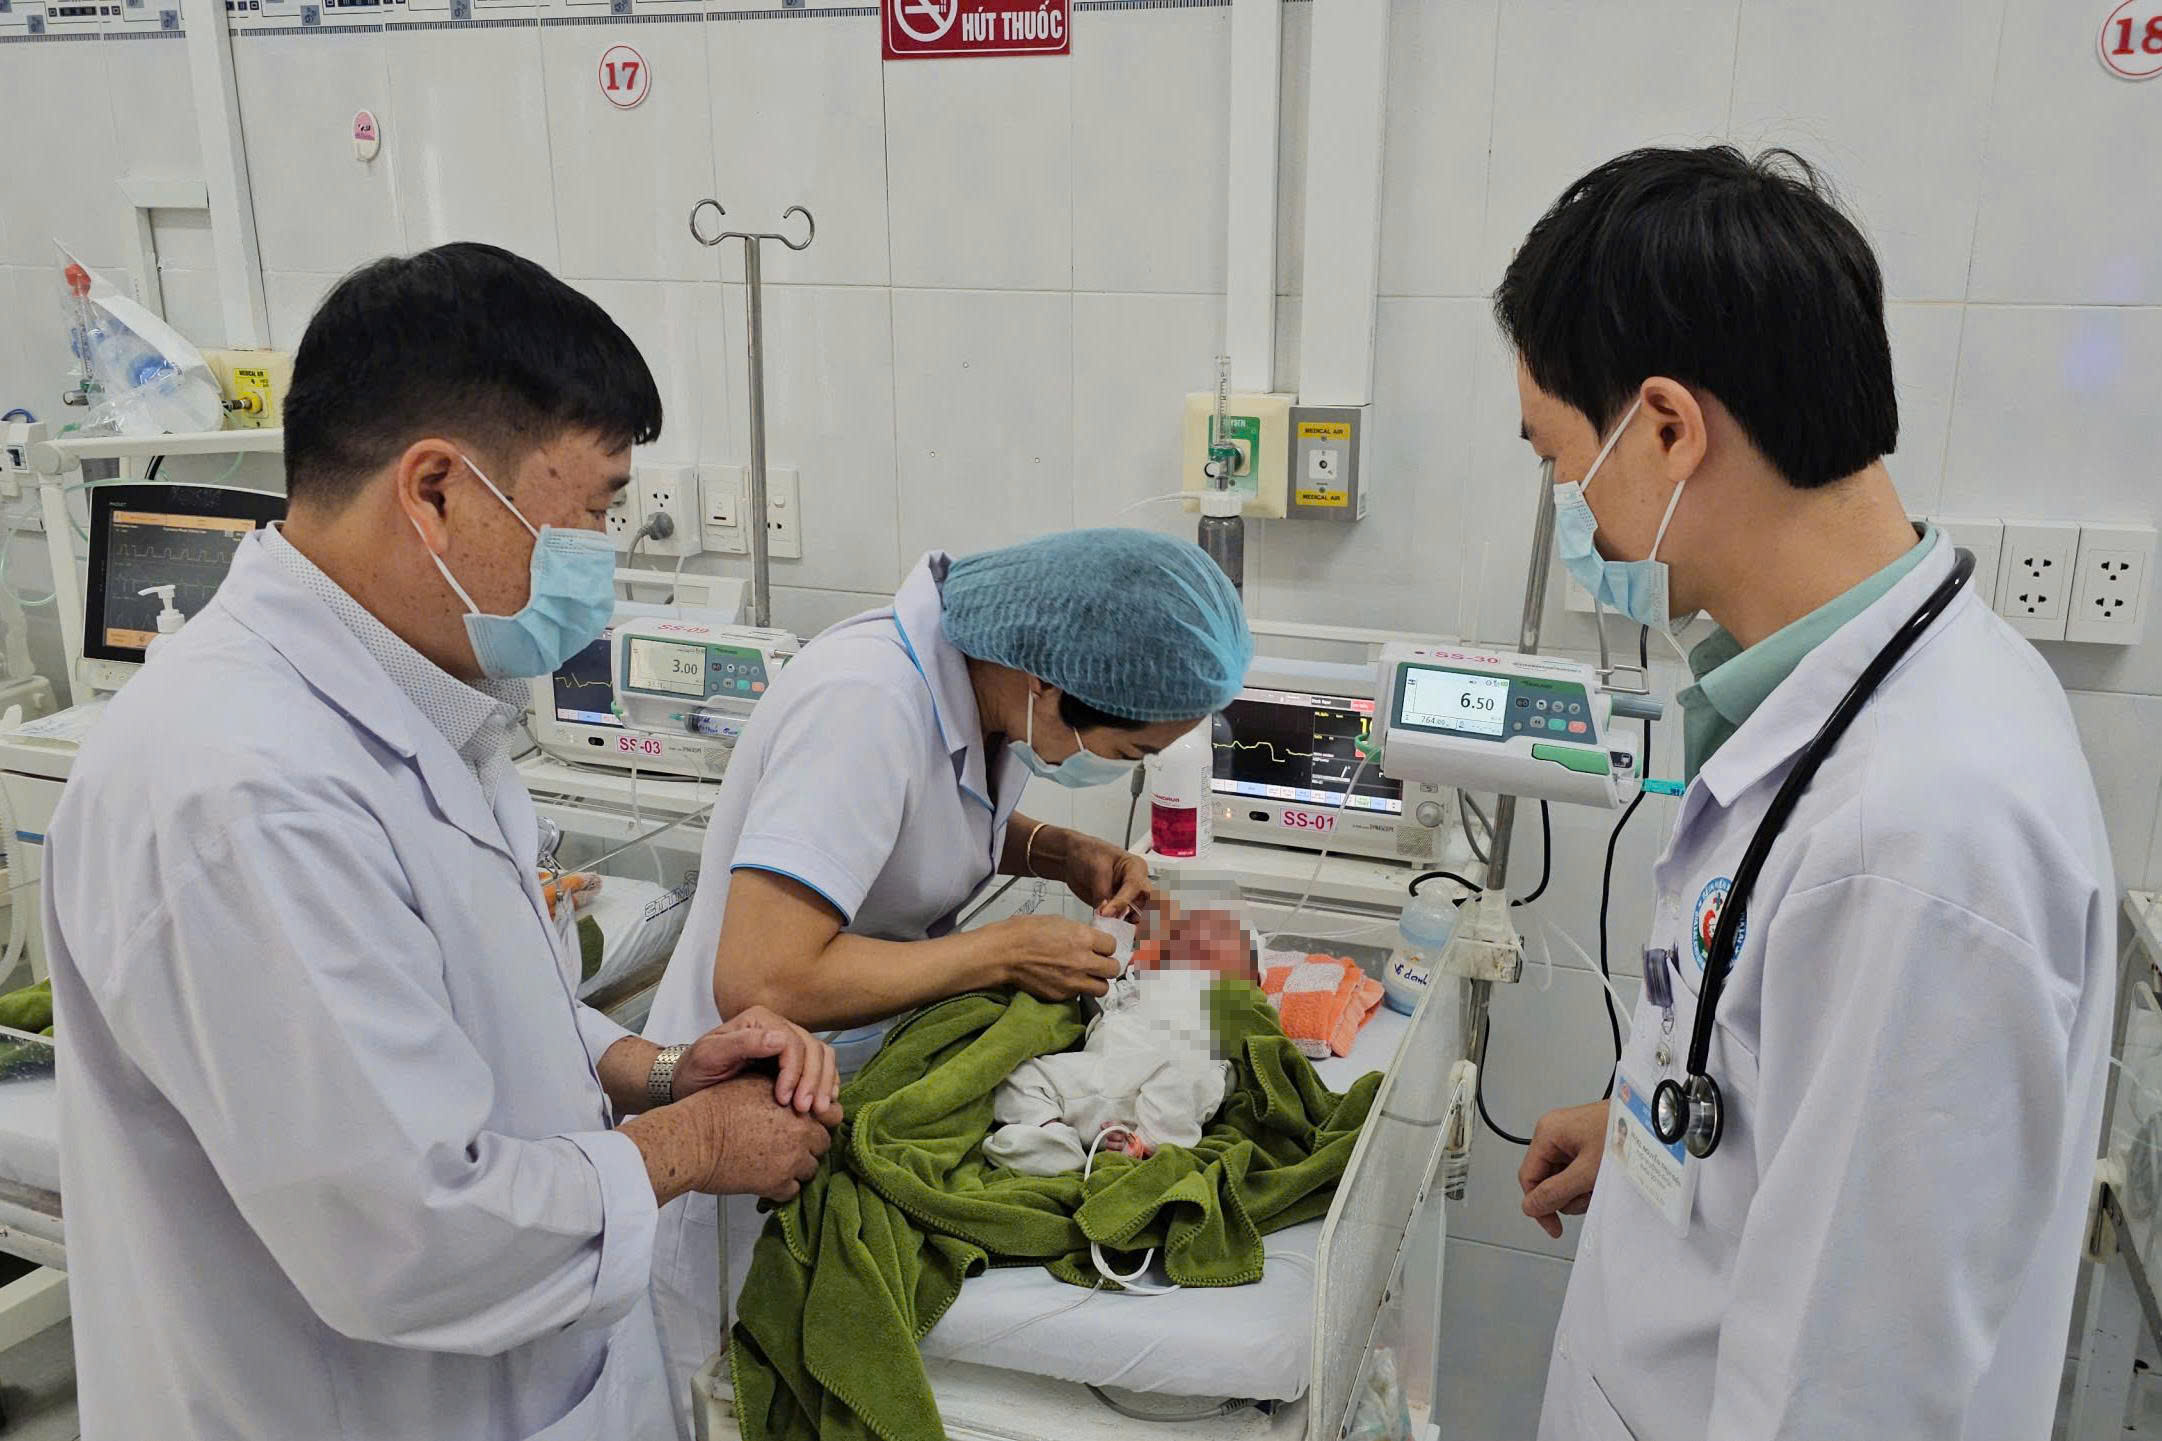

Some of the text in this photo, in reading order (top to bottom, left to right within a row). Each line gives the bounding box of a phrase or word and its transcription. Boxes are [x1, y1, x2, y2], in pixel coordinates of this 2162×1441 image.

[961, 0, 1063, 41] HÚT THUỐC
[2111, 15, 2162, 55] 18
[605, 61, 640, 91] 17
[672, 659, 698, 675] 3.00
[1435, 651, 1499, 664] SS-30
[1460, 692, 1495, 711] 6.50
[619, 737, 661, 755] SS-03
[1284, 811, 1335, 832] SS-01
